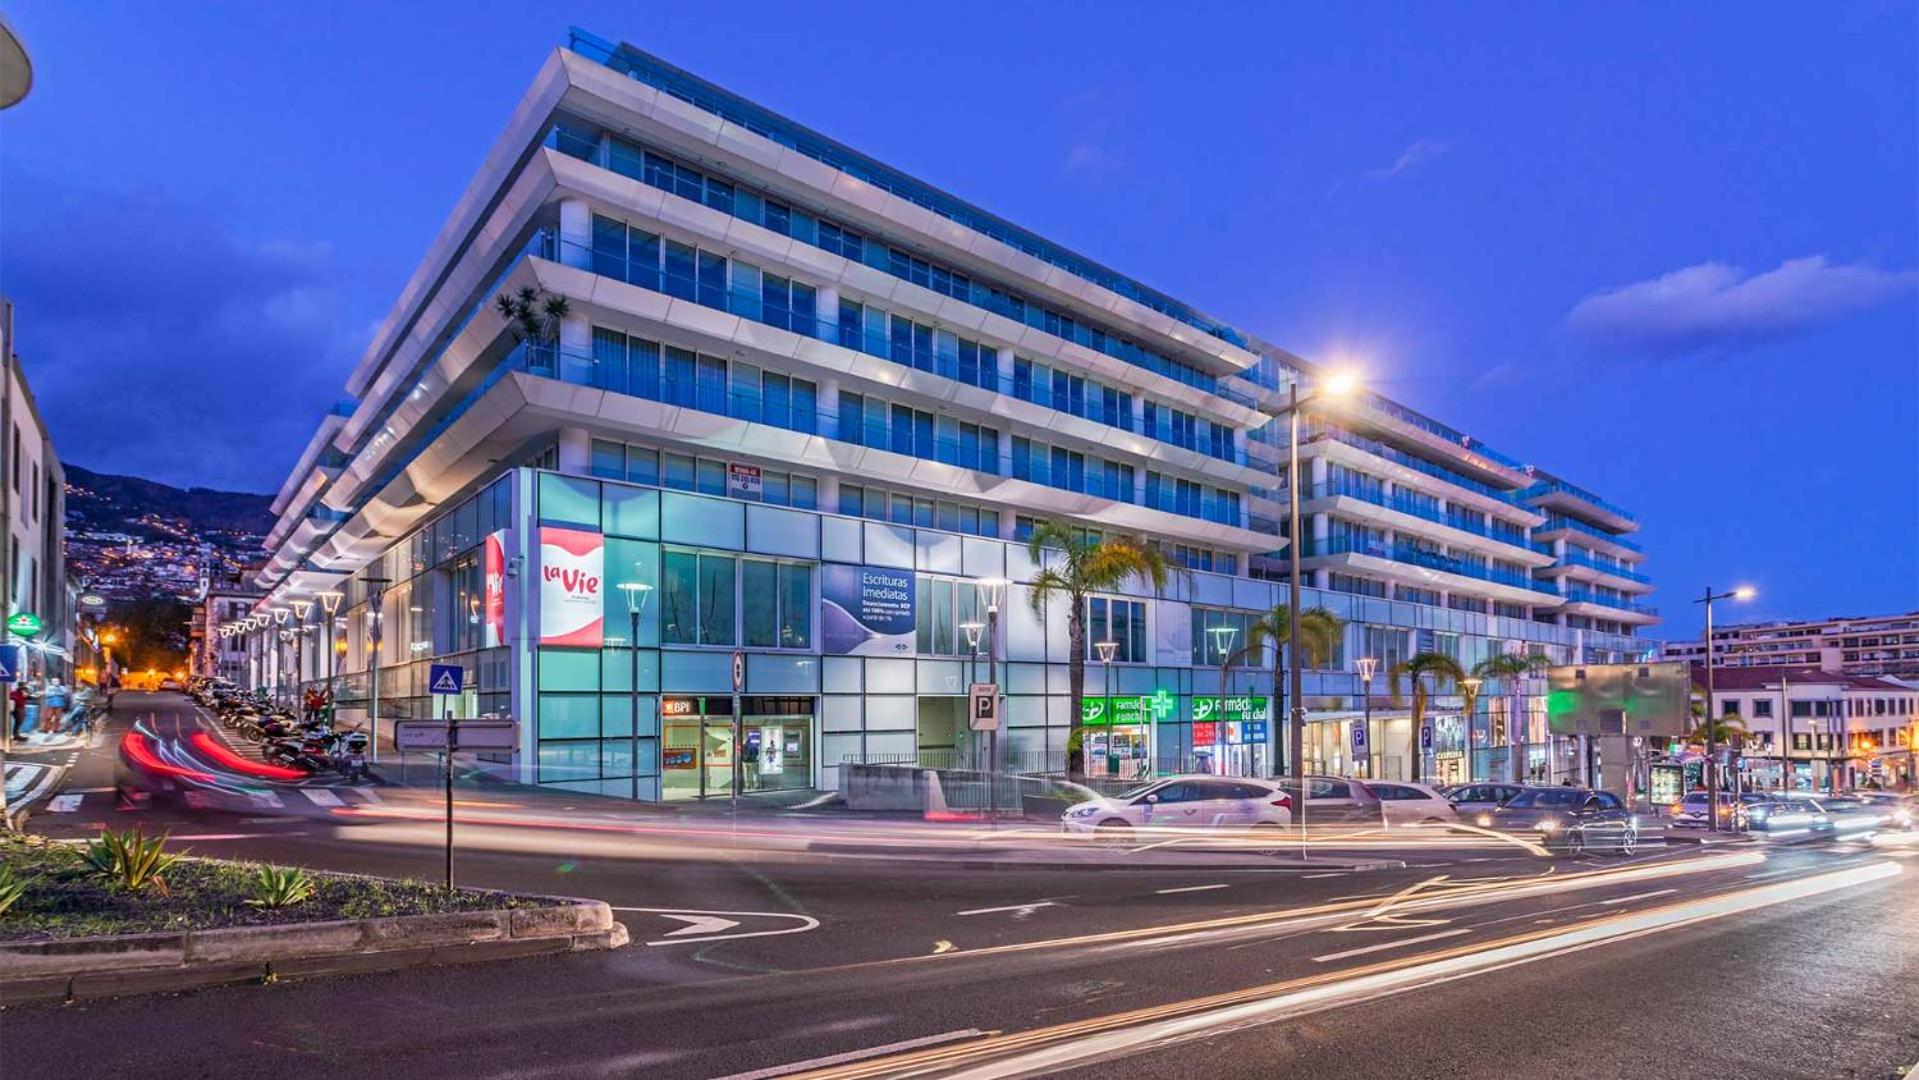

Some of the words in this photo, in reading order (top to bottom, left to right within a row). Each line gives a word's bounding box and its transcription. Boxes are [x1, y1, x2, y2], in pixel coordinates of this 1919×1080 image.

[544, 565, 560, 582] la
[562, 569, 598, 593] Vie
[863, 573, 908, 587] Escrituras
[862, 585, 908, 600] Imediatas
[674, 701, 690, 713] BPI
[979, 697, 991, 717] P
[1241, 708, 1266, 720] Fuchal
[1356, 731, 1362, 744] P
[1423, 729, 1430, 746] P
